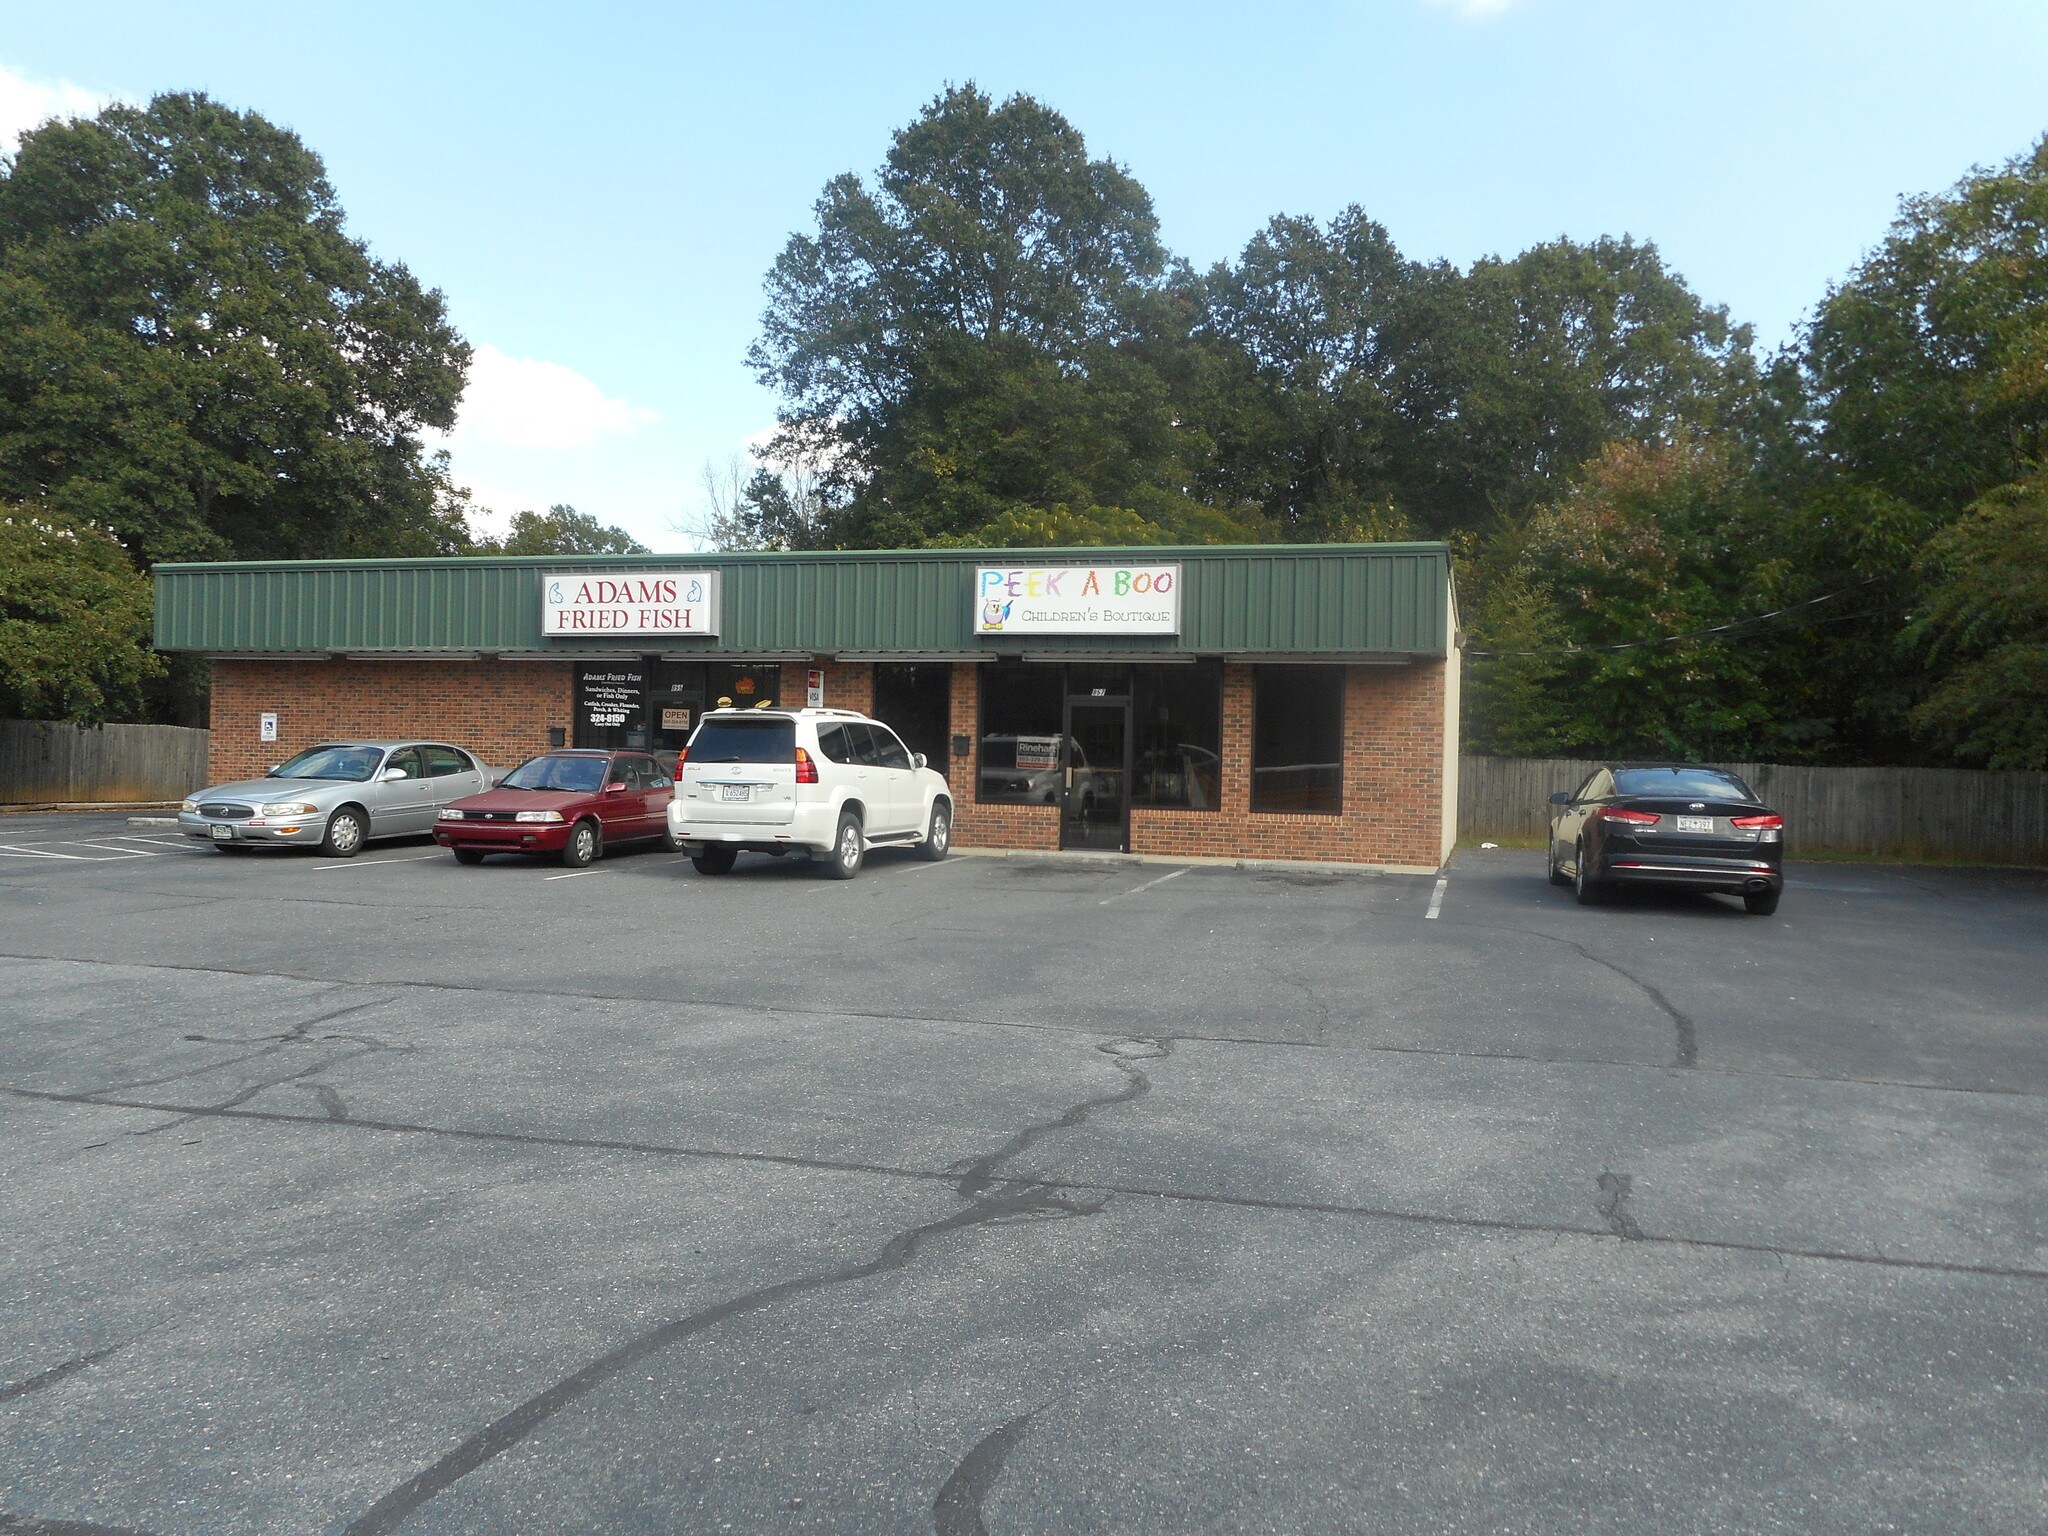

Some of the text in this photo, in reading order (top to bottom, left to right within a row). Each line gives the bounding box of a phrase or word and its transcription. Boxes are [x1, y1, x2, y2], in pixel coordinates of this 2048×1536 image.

[980, 569, 1173, 598] PEEK A BOO
[574, 580, 677, 604] ADAMS
[557, 609, 692, 629] FRIED FISH
[809, 692, 820, 701] VISA
[590, 713, 625, 723] 324-8150
[664, 711, 688, 719] OPEN
